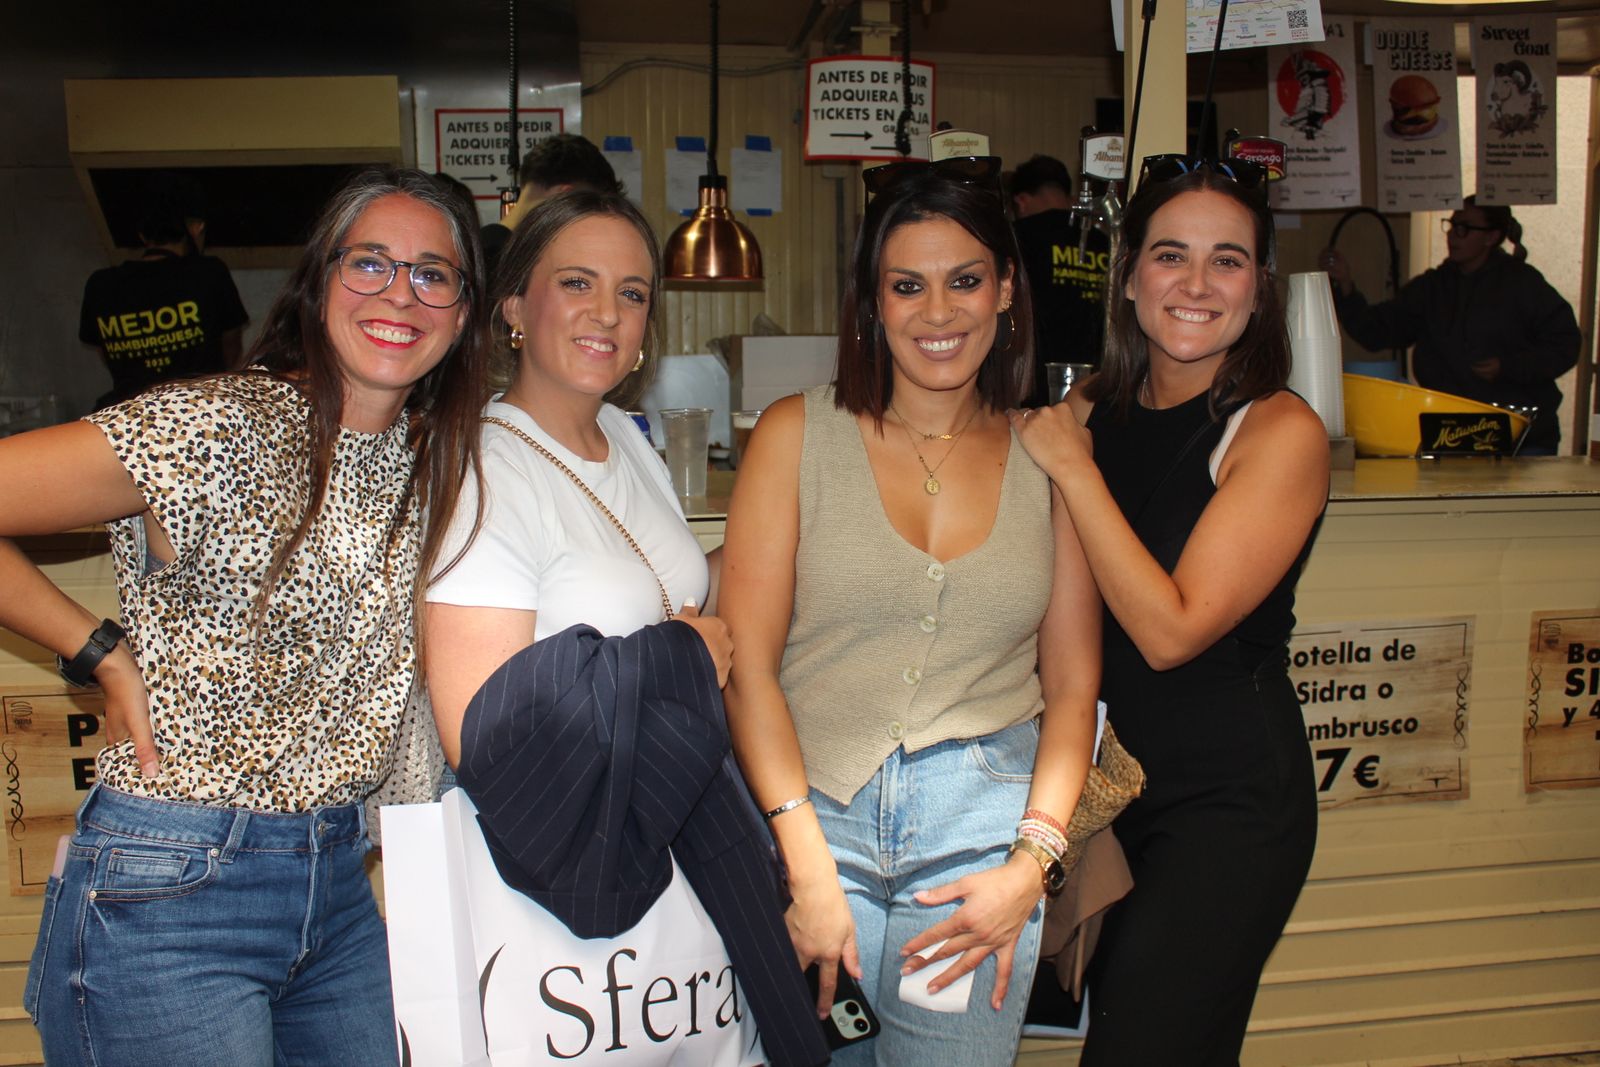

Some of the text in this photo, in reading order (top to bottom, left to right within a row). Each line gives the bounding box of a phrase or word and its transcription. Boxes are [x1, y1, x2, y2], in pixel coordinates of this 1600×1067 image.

[1375, 30, 1429, 50] DOBLE
[1481, 25, 1530, 41] Sweet
[1513, 41, 1550, 56] Goat
[1390, 51, 1453, 71] CHEESE
[817, 70, 927, 88] ANTES DE PDIR
[820, 89, 925, 106] ADQUIERA US
[812, 107, 930, 125] TICKETS EN AJA
[447, 121, 489, 133] ANTES
[494, 121, 513, 133] DE
[450, 138, 511, 150] ADQUIER
[445, 154, 513, 166] TICKETS E
[1092, 151, 1125, 163] Alham
[1052, 245, 1110, 272] MEJO
[97, 301, 200, 339] MEJOR
[105, 326, 204, 353] HAMBURGUESA
[1432, 417, 1501, 450] Matusalem
[1382, 638, 1416, 662] de
[1296, 679, 1394, 706] Sidra o
[1562, 707, 1578, 728] y
[1307, 716, 1419, 741] mbrusco
[1315, 747, 1381, 792] 7€
[539, 948, 744, 1060] Sfera
